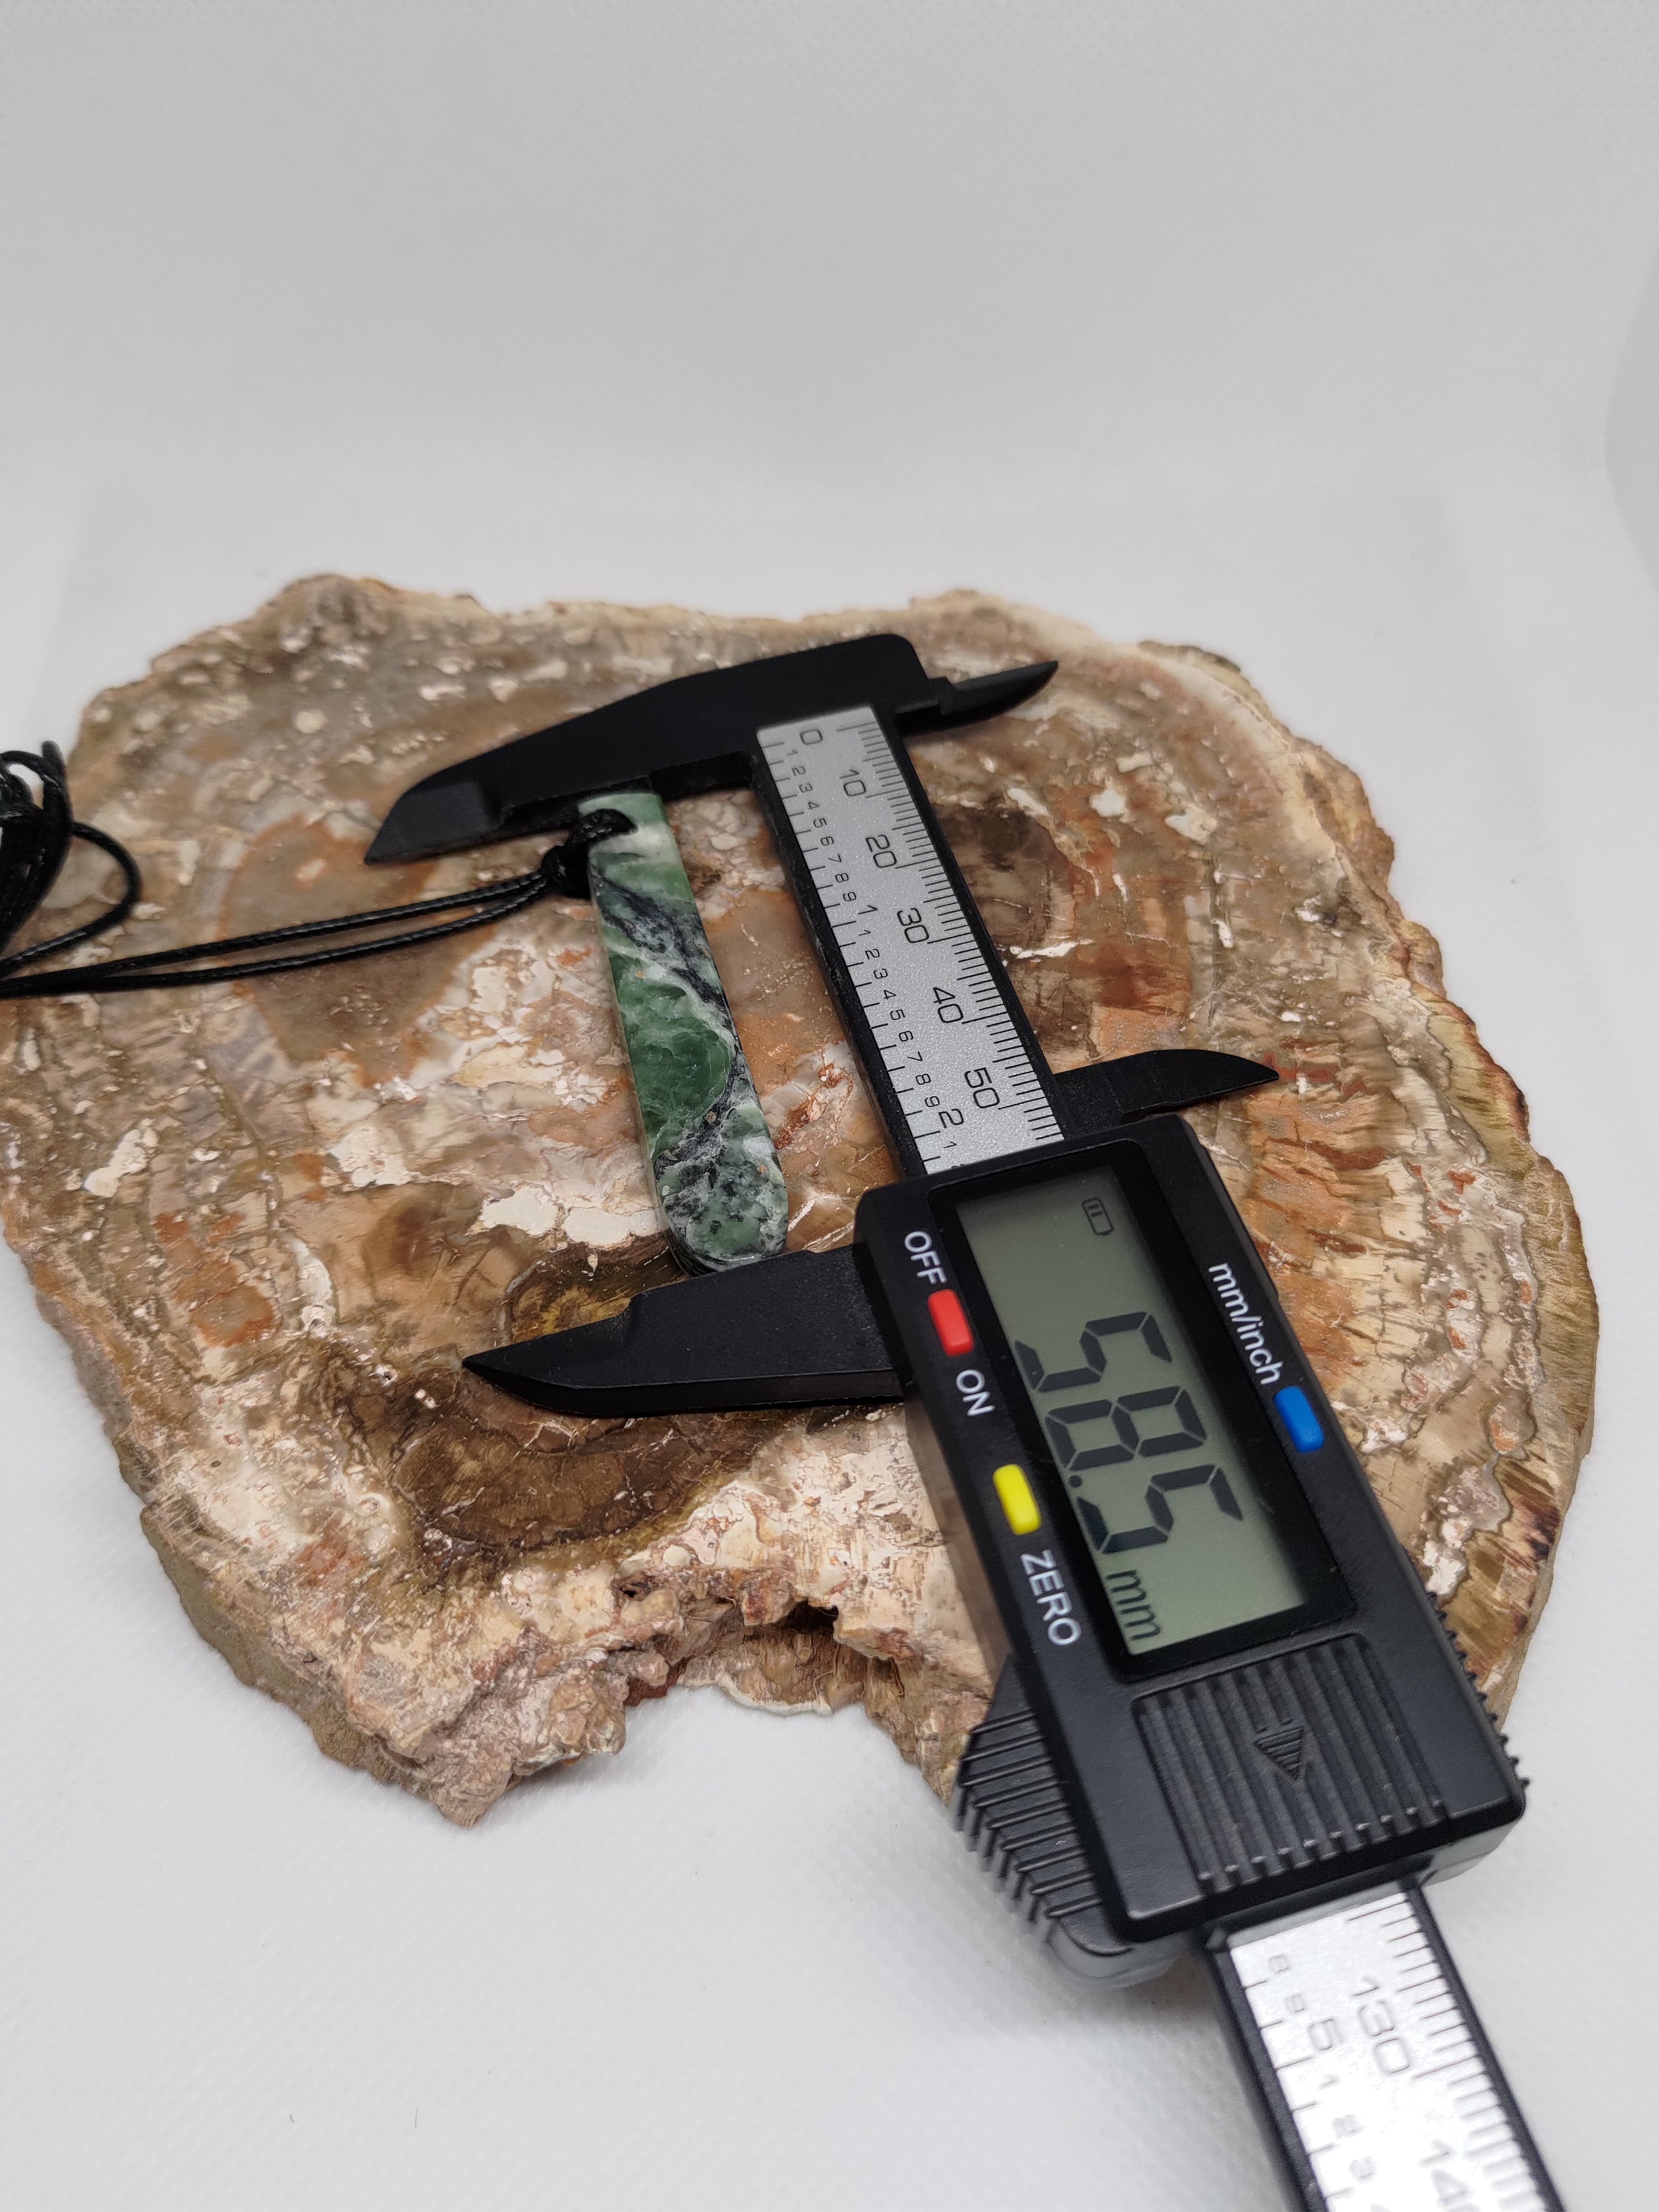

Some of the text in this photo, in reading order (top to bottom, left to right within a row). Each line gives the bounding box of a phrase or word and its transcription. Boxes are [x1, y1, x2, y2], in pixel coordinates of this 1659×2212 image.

[791, 766, 806, 775] 2
[799, 783, 812, 793] 3
[807, 801, 820, 811] 4
[813, 817, 827, 829] 5
[820, 836, 834, 846] 6
[828, 854, 842, 864] 7
[834, 873, 849, 883] 8
[843, 891, 857, 902] 9
[858, 904, 878, 915] 1
[800, 728, 1000, 1109] 0 10 20 30 40 50
[865, 948, 880, 959] 2
[873, 968, 888, 979] 3
[883, 989, 897, 1000] 4
[889, 1009, 905, 1020] 5
[898, 1031, 914, 1042] 6
[907, 1051, 923, 1062] 7
[915, 1073, 931, 1085] 8
[924, 1095, 940, 1107] 9
[938, 1108, 964, 1129] 2
[904, 1231, 948, 1285] OFF
[1208, 1262, 1282, 1385] mm/inch
[955, 1369, 995, 1416] ON
[1014, 1311, 1243, 1641] 58.5 mm
[1020, 1549, 1082, 1645] ZERO
[1351, 1977, 1481, 2212] 130 14
